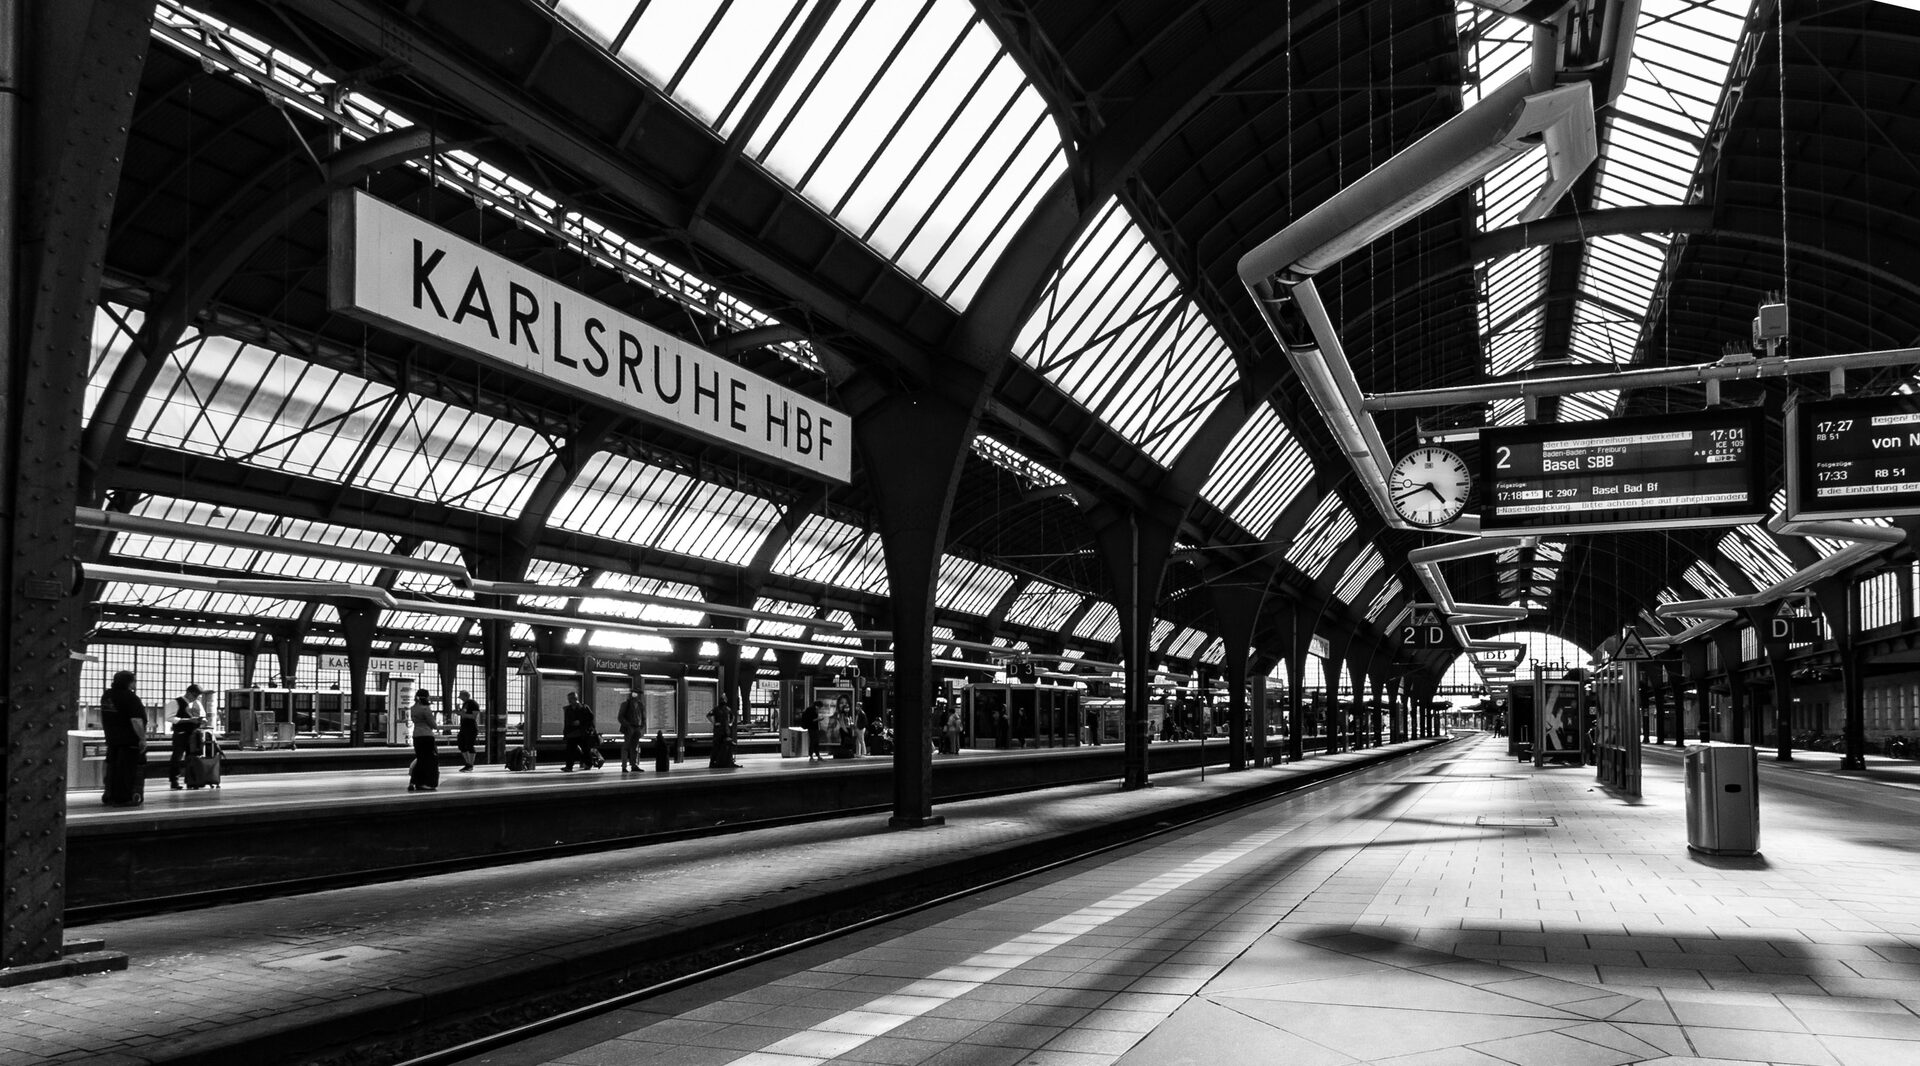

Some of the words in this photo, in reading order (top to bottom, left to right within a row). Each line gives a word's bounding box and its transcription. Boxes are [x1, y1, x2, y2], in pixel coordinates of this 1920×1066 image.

[413, 238, 747, 433] KARLSRUHE
[766, 393, 833, 461] HBF
[1817, 419, 1854, 433] 17:27
[1710, 428, 1743, 441] 17:01
[1715, 441, 1727, 449] ICE
[1731, 439, 1744, 448] 109
[1872, 437, 1901, 449] von
[1496, 446, 1511, 469] 2
[1543, 448, 1587, 458] Baden-Baden
[1597, 446, 1627, 455] Freiburg
[1543, 457, 1580, 472] Basel
[1587, 455, 1614, 469] SBB
[1817, 470, 1848, 481] 17:33
[1875, 469, 1889, 478] RB
[1893, 468, 1906, 477] 51
[1497, 491, 1522, 501] 17:18
[1545, 490, 1553, 498] IC
[1556, 488, 1578, 498] 2907
[1592, 485, 1620, 495] Basel
[1624, 483, 1643, 494] Bad
[1647, 482, 1658, 492] Bf
[1827, 486, 1842, 495] die
[1902, 482, 1919, 491] der
[1641, 498, 1654, 506] Sie
[1772, 619, 1789, 638] D
[1811, 617, 1821, 637] 1
[1404, 627, 1416, 644] 2
[1429, 626, 1443, 644] D
[398, 660, 419, 671] HBF
[596, 658, 628, 670] Karlsruhe
[629, 660, 641, 671] Hbf
[1010, 664, 1018, 675] D
[1025, 664, 1033, 675] 3
[840, 667, 847, 677] 4
[853, 667, 861, 678] D
